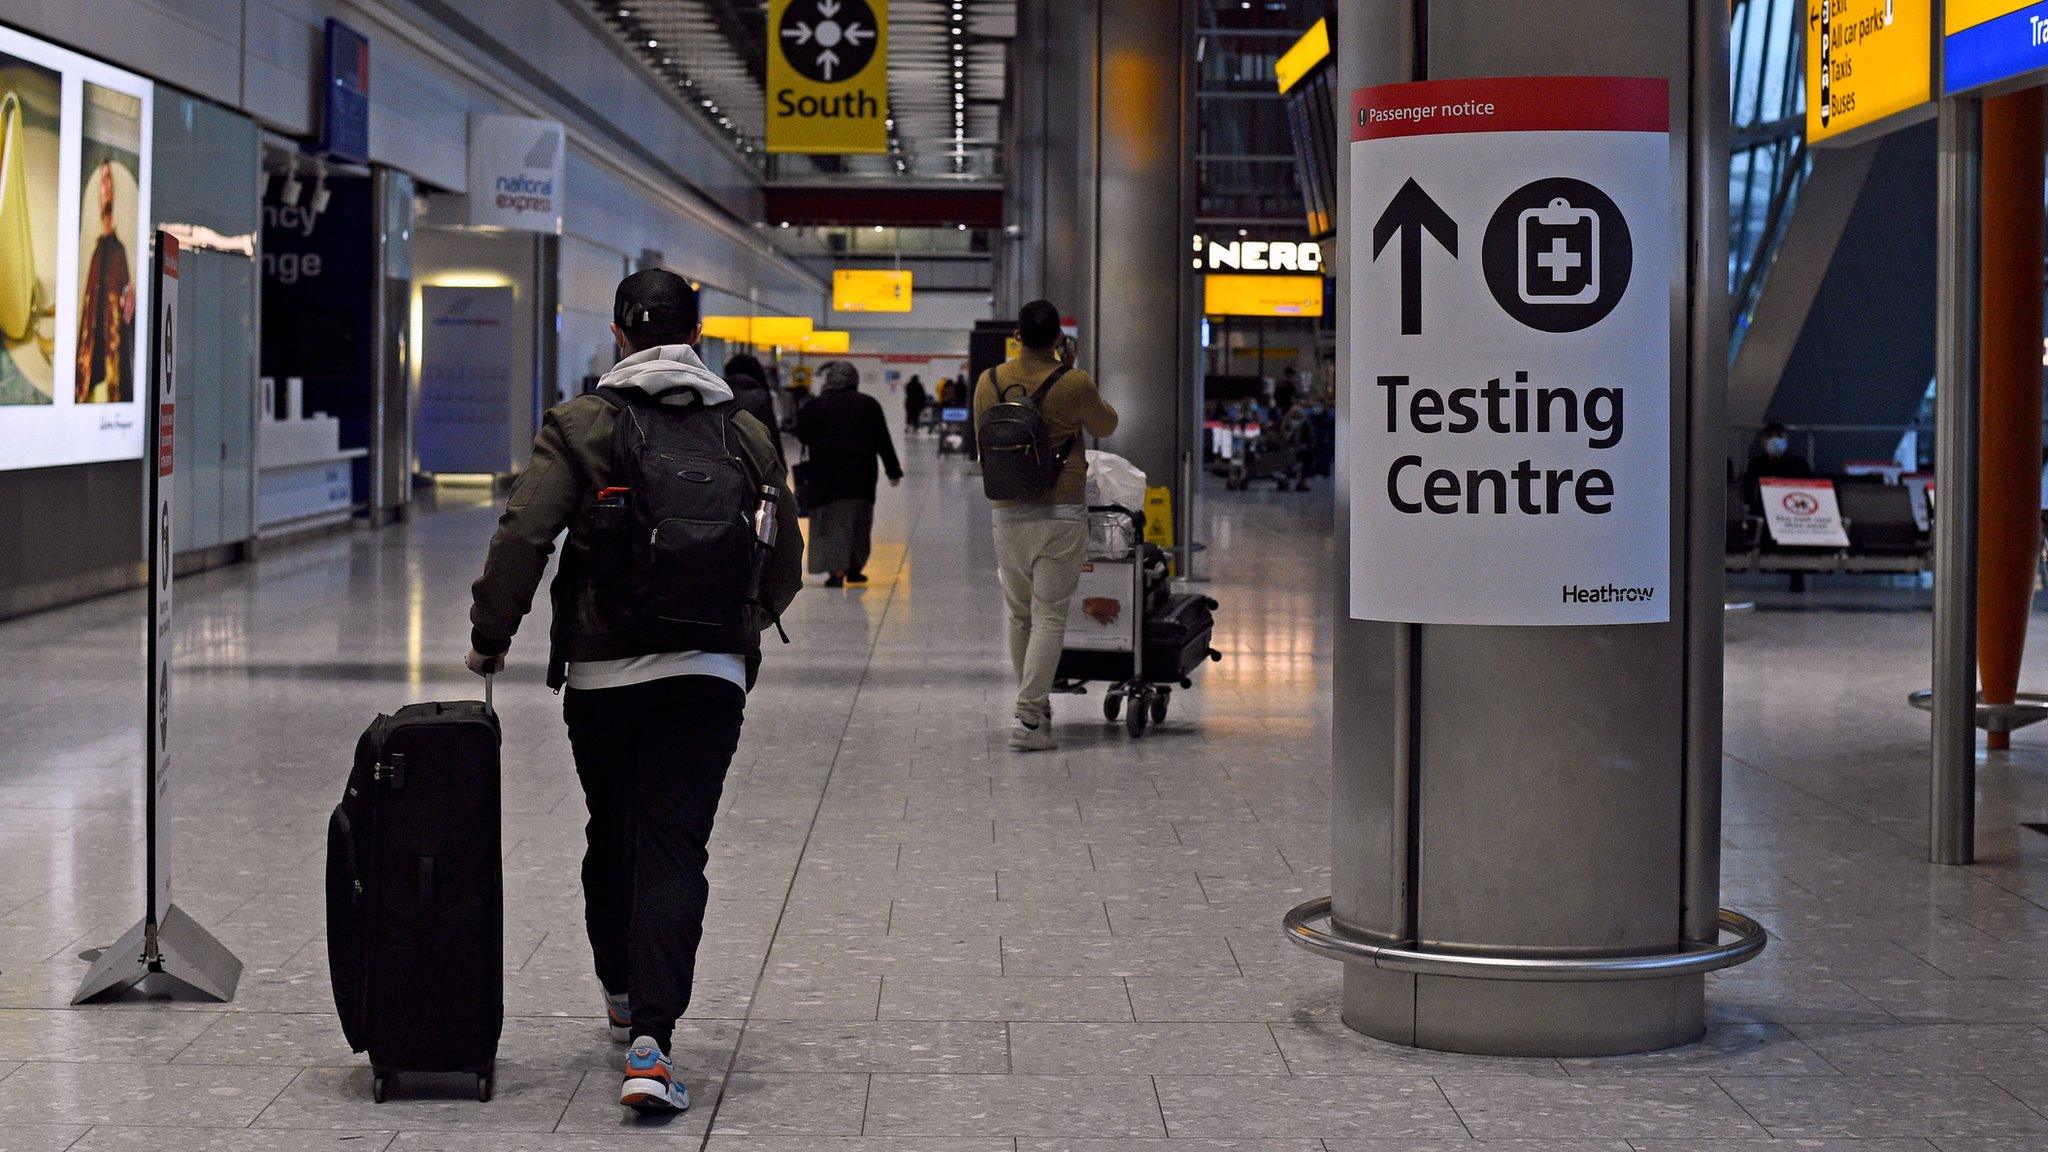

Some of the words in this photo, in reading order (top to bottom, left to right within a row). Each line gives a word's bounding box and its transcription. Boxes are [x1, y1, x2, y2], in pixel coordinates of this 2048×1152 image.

[1831, 23, 1843, 51] All
[1844, 23, 1857, 46] car
[1859, 7, 1884, 46] parks
[1831, 53, 1852, 83] Taxis
[777, 88, 878, 118] South
[1369, 105, 1437, 122] Passenger
[1441, 100, 1495, 116] notice
[1831, 92, 1856, 117] Buses
[1208, 241, 1322, 271] NERO
[1377, 371, 1623, 449] Testing
[1387, 455, 1615, 515] Centre
[1562, 583, 1654, 603] Heathrow
